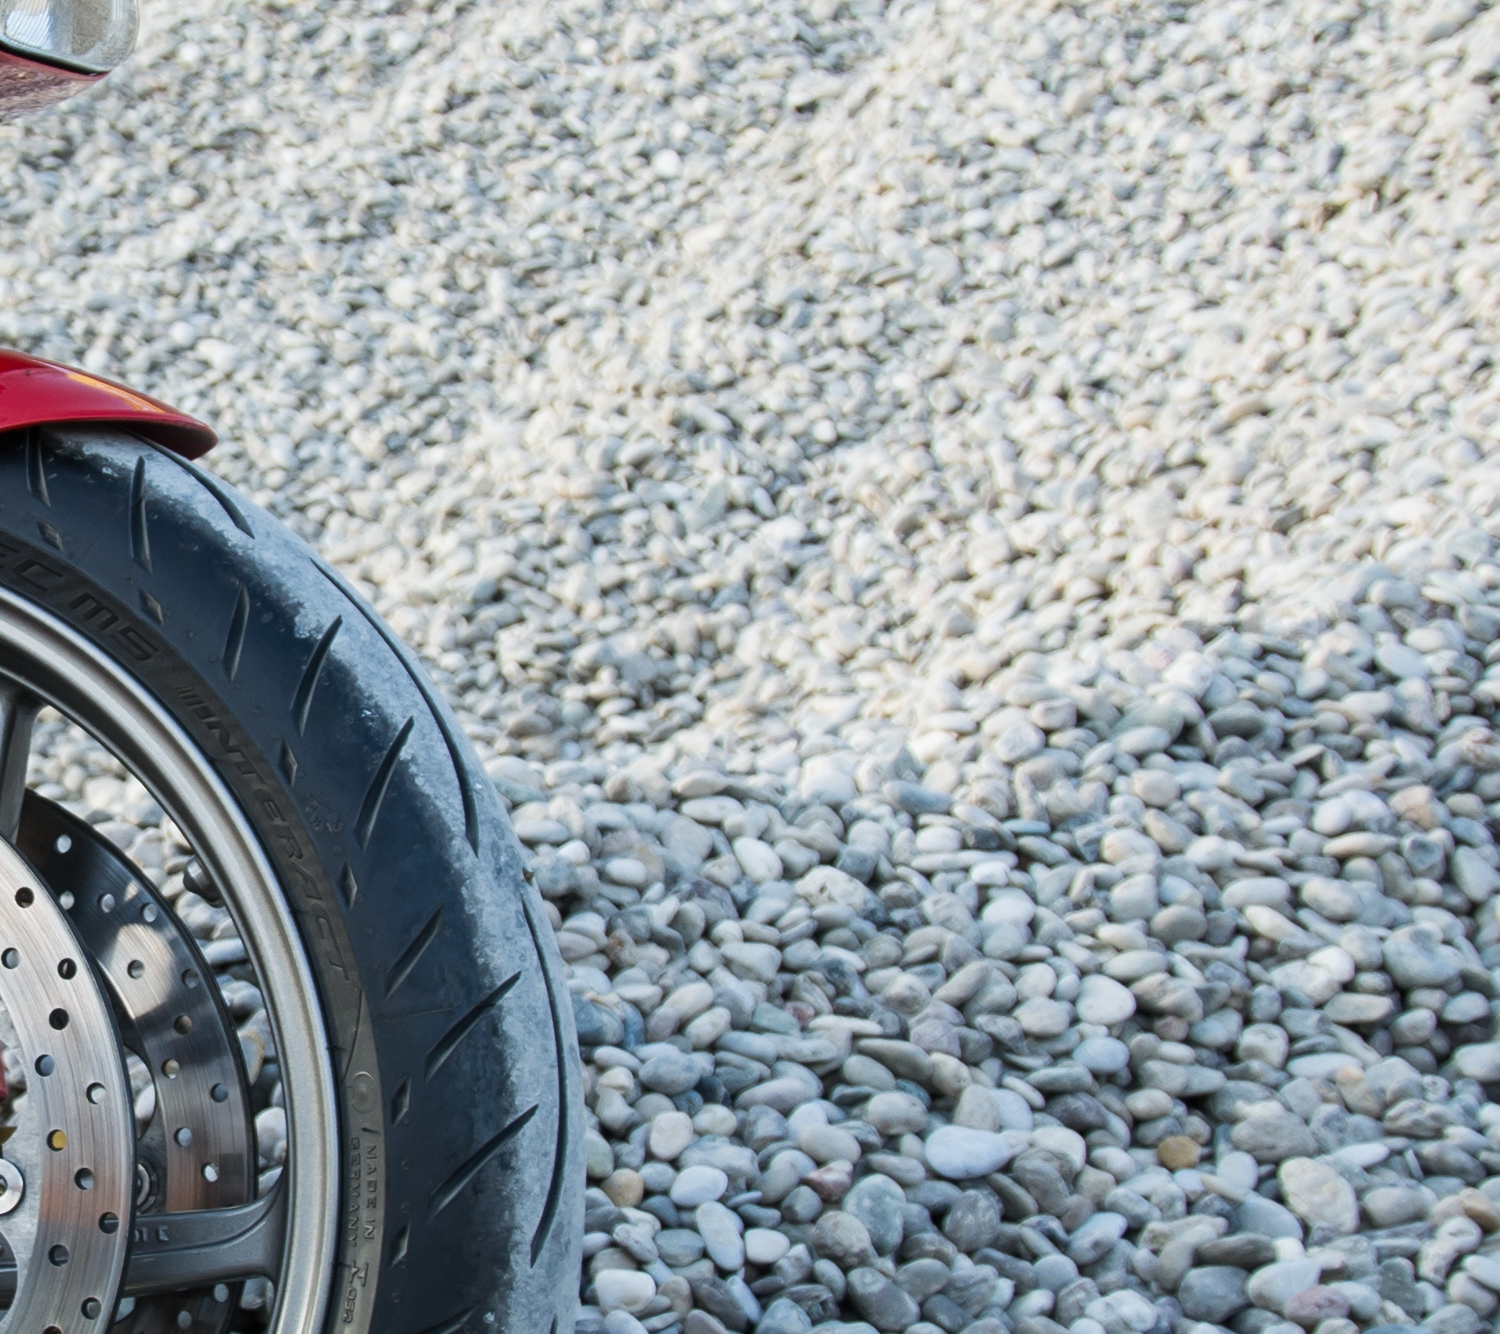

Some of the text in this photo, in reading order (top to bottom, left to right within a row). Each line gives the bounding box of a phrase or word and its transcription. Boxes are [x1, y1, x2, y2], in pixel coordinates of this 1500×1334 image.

[178, 689, 350, 981] INTERACT
[348, 1136, 362, 1248] GERMANY
[366, 1144, 378, 1209] MADE
